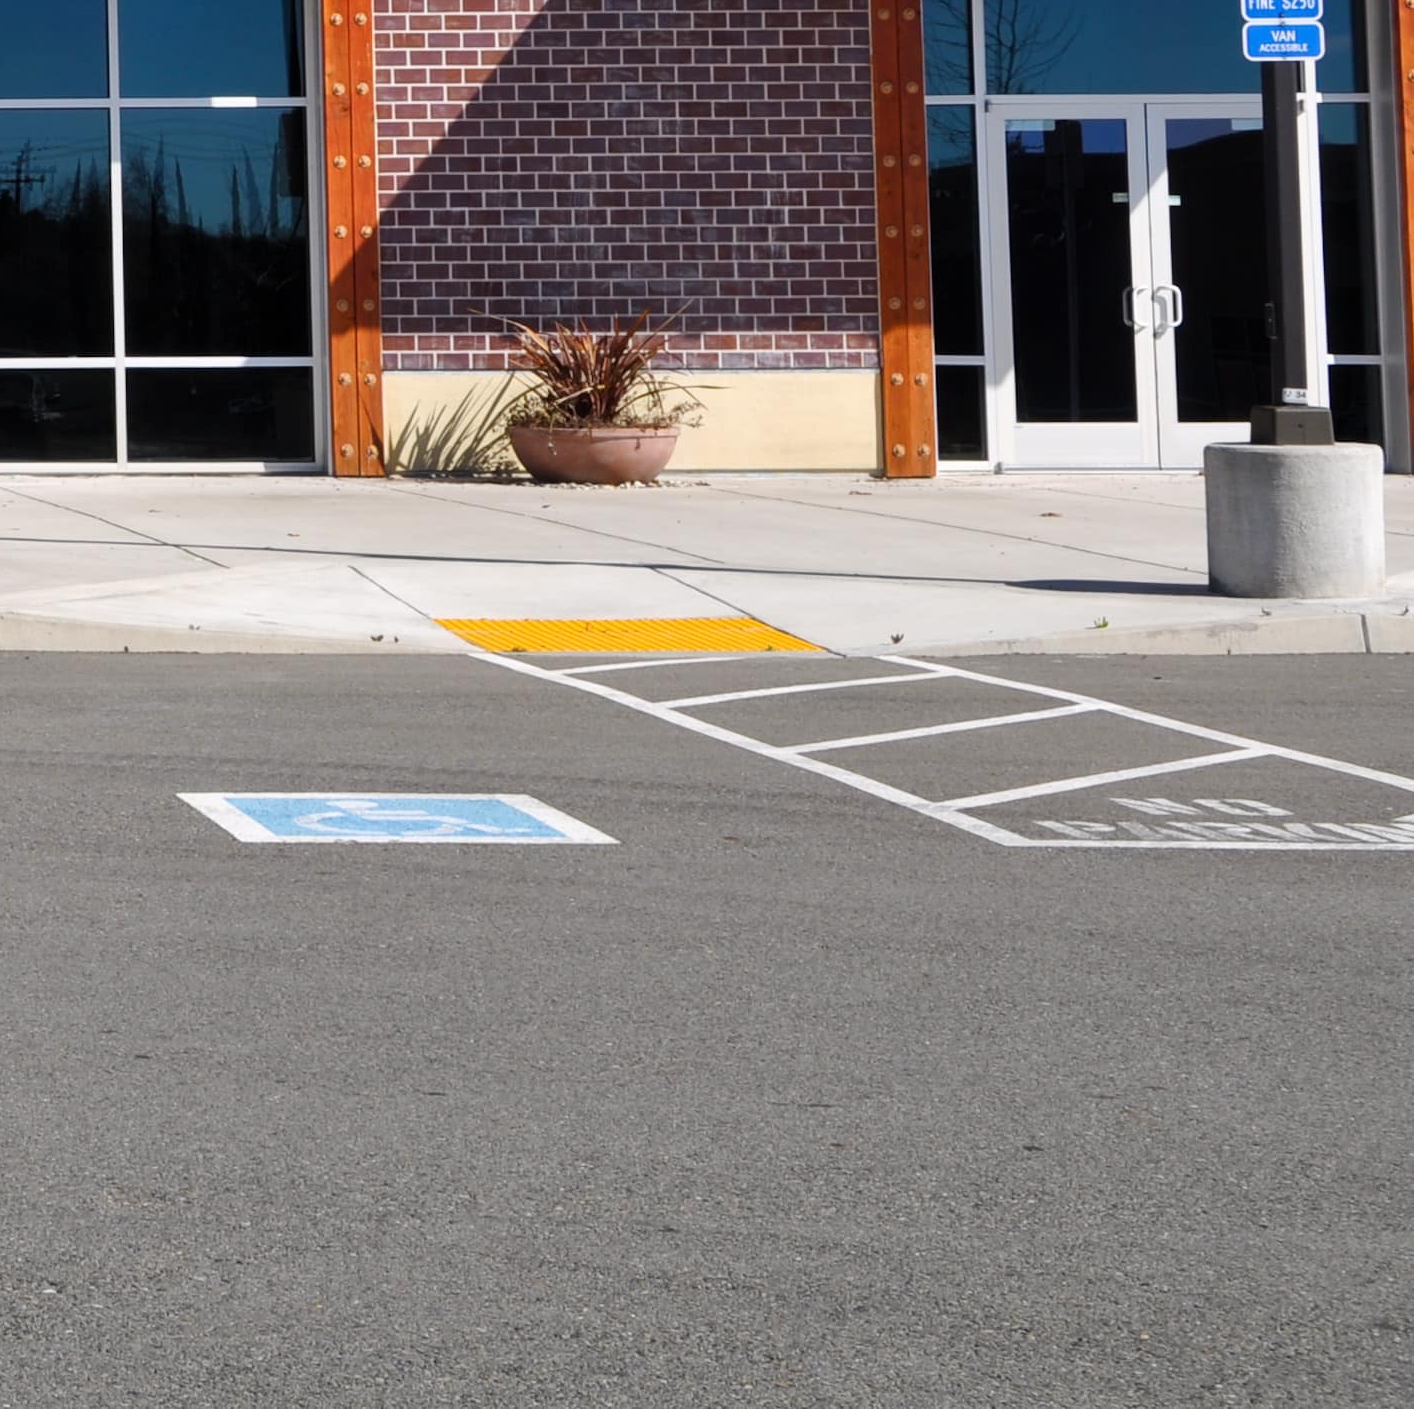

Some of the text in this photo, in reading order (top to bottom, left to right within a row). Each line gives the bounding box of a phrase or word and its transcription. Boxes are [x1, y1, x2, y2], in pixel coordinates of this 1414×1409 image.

[1271, 30, 1296, 42] VAN
[1109, 797, 1294, 816] NO
[1033, 820, 1414, 842] PARKIN
